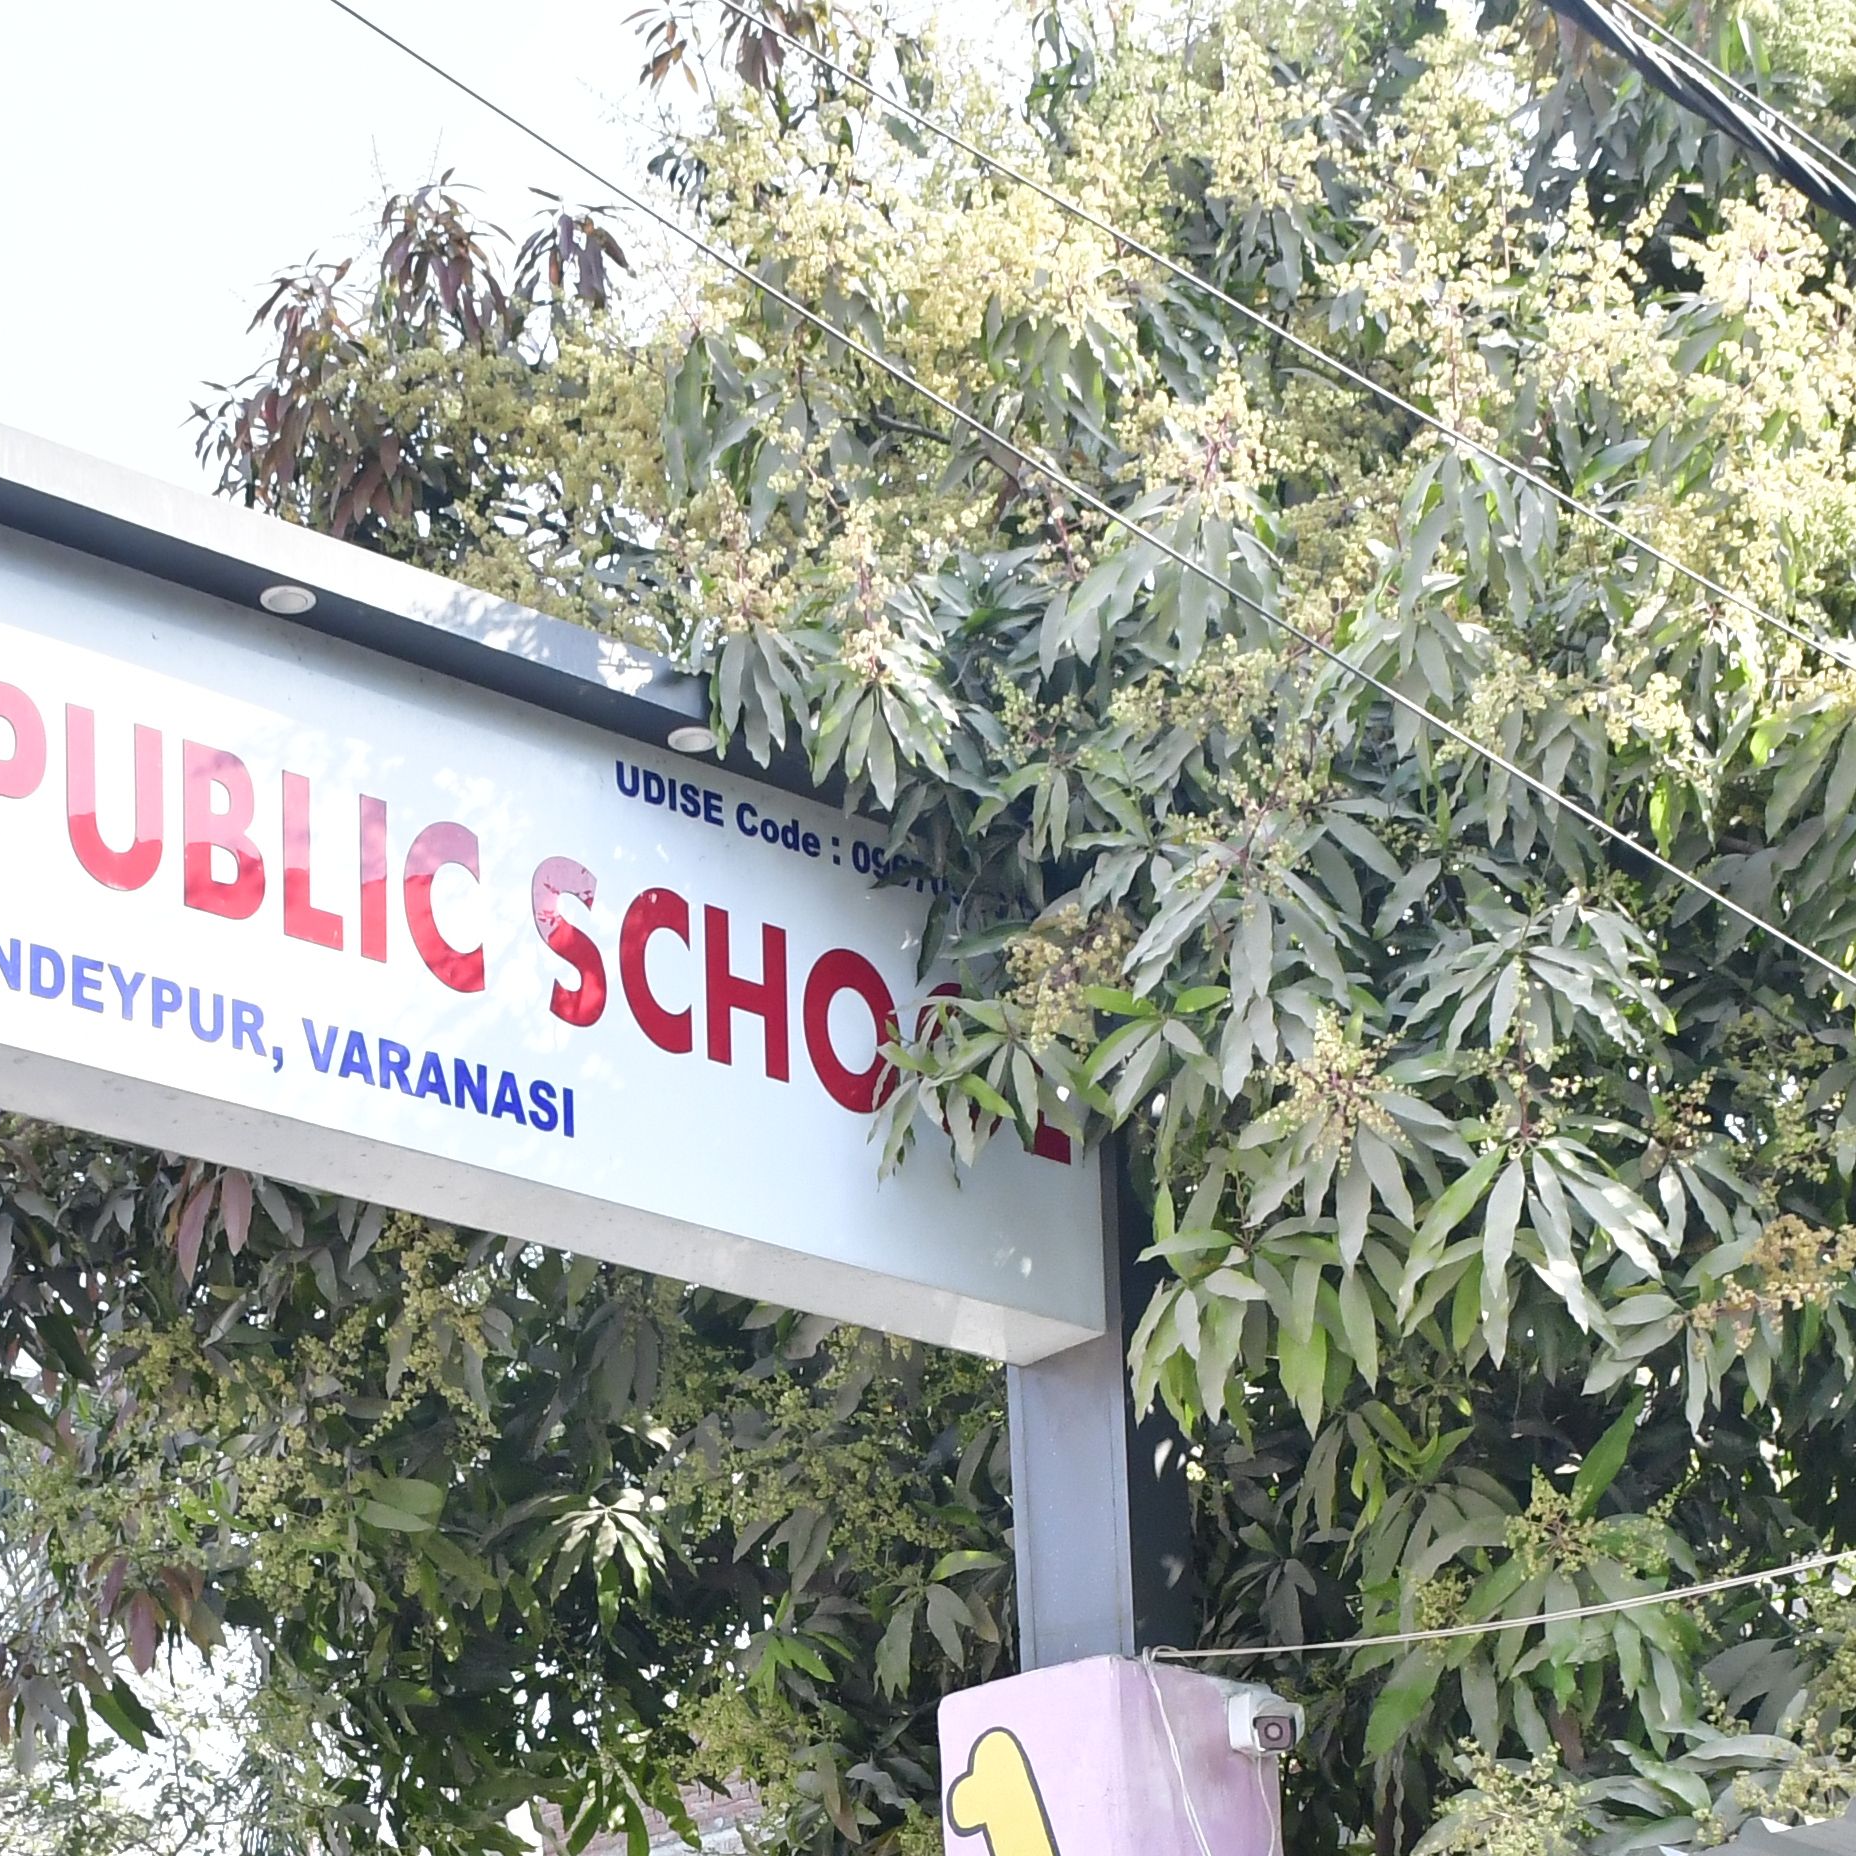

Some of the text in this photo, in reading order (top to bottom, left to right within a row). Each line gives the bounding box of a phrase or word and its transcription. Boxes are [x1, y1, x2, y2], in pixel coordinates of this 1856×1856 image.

[615, 760, 724, 828] UDISE
[735, 802, 822, 858] Code
[532, 856, 1071, 1165] SCHO
[302, 1017, 575, 1138] VARANASI
